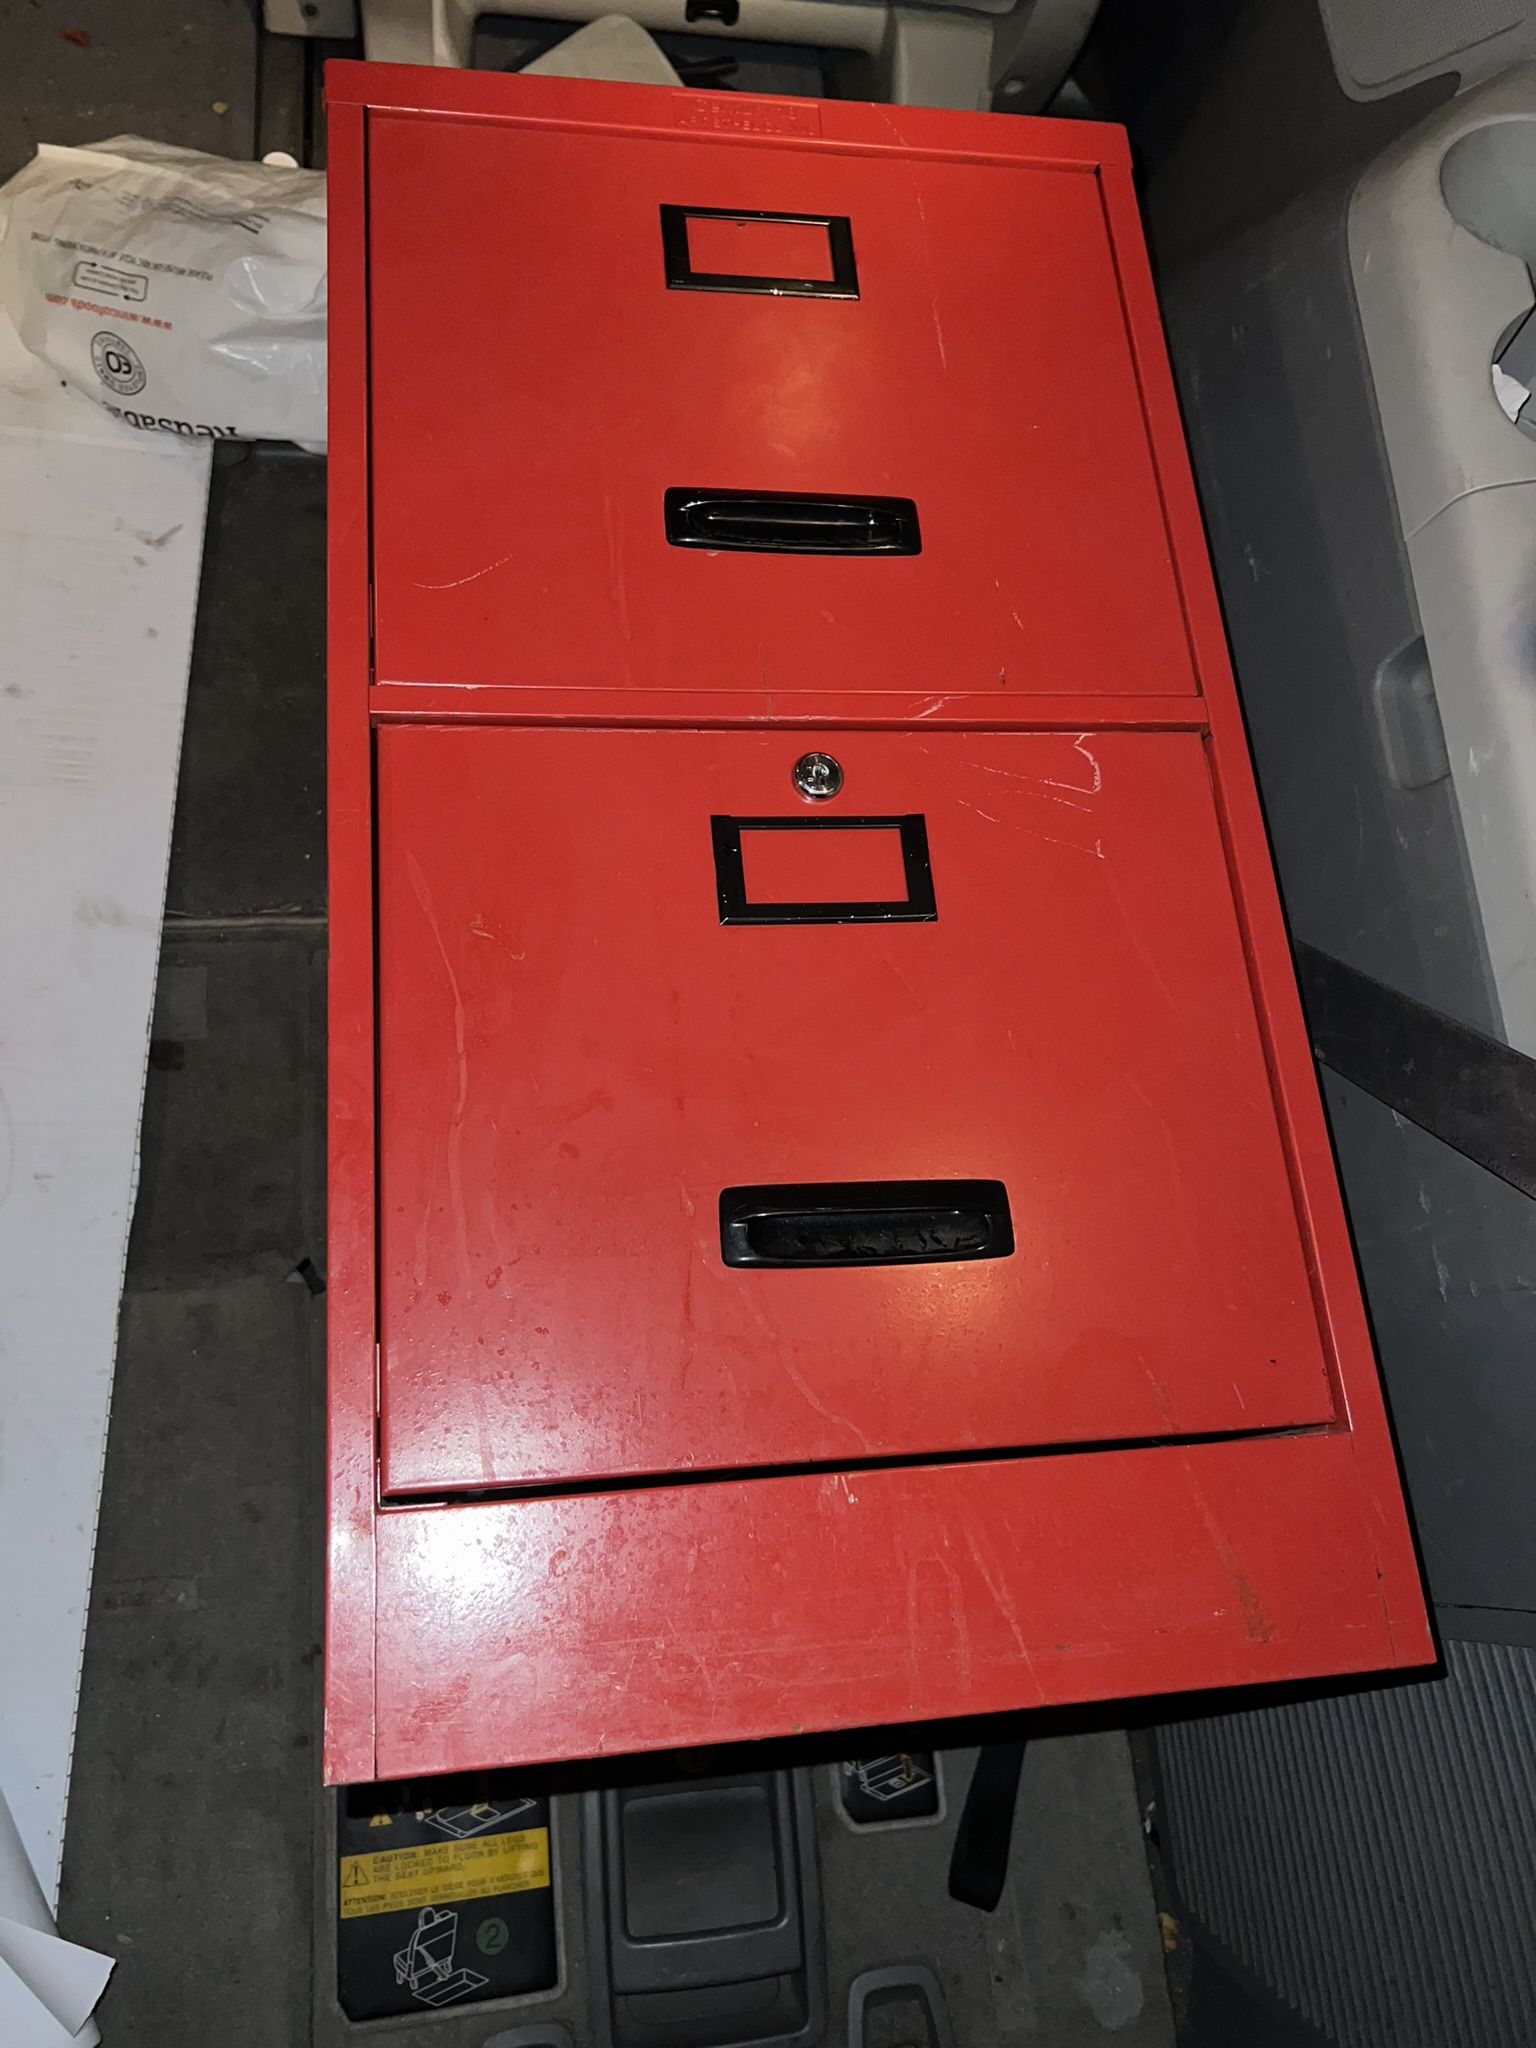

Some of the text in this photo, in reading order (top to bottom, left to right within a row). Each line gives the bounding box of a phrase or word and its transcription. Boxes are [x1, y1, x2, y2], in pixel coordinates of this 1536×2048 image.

[437, 1857, 449, 1866] TO
[373, 1873, 391, 1883] THE
[395, 1869, 419, 1880] SEAT
[486, 1923, 502, 1949] 2
